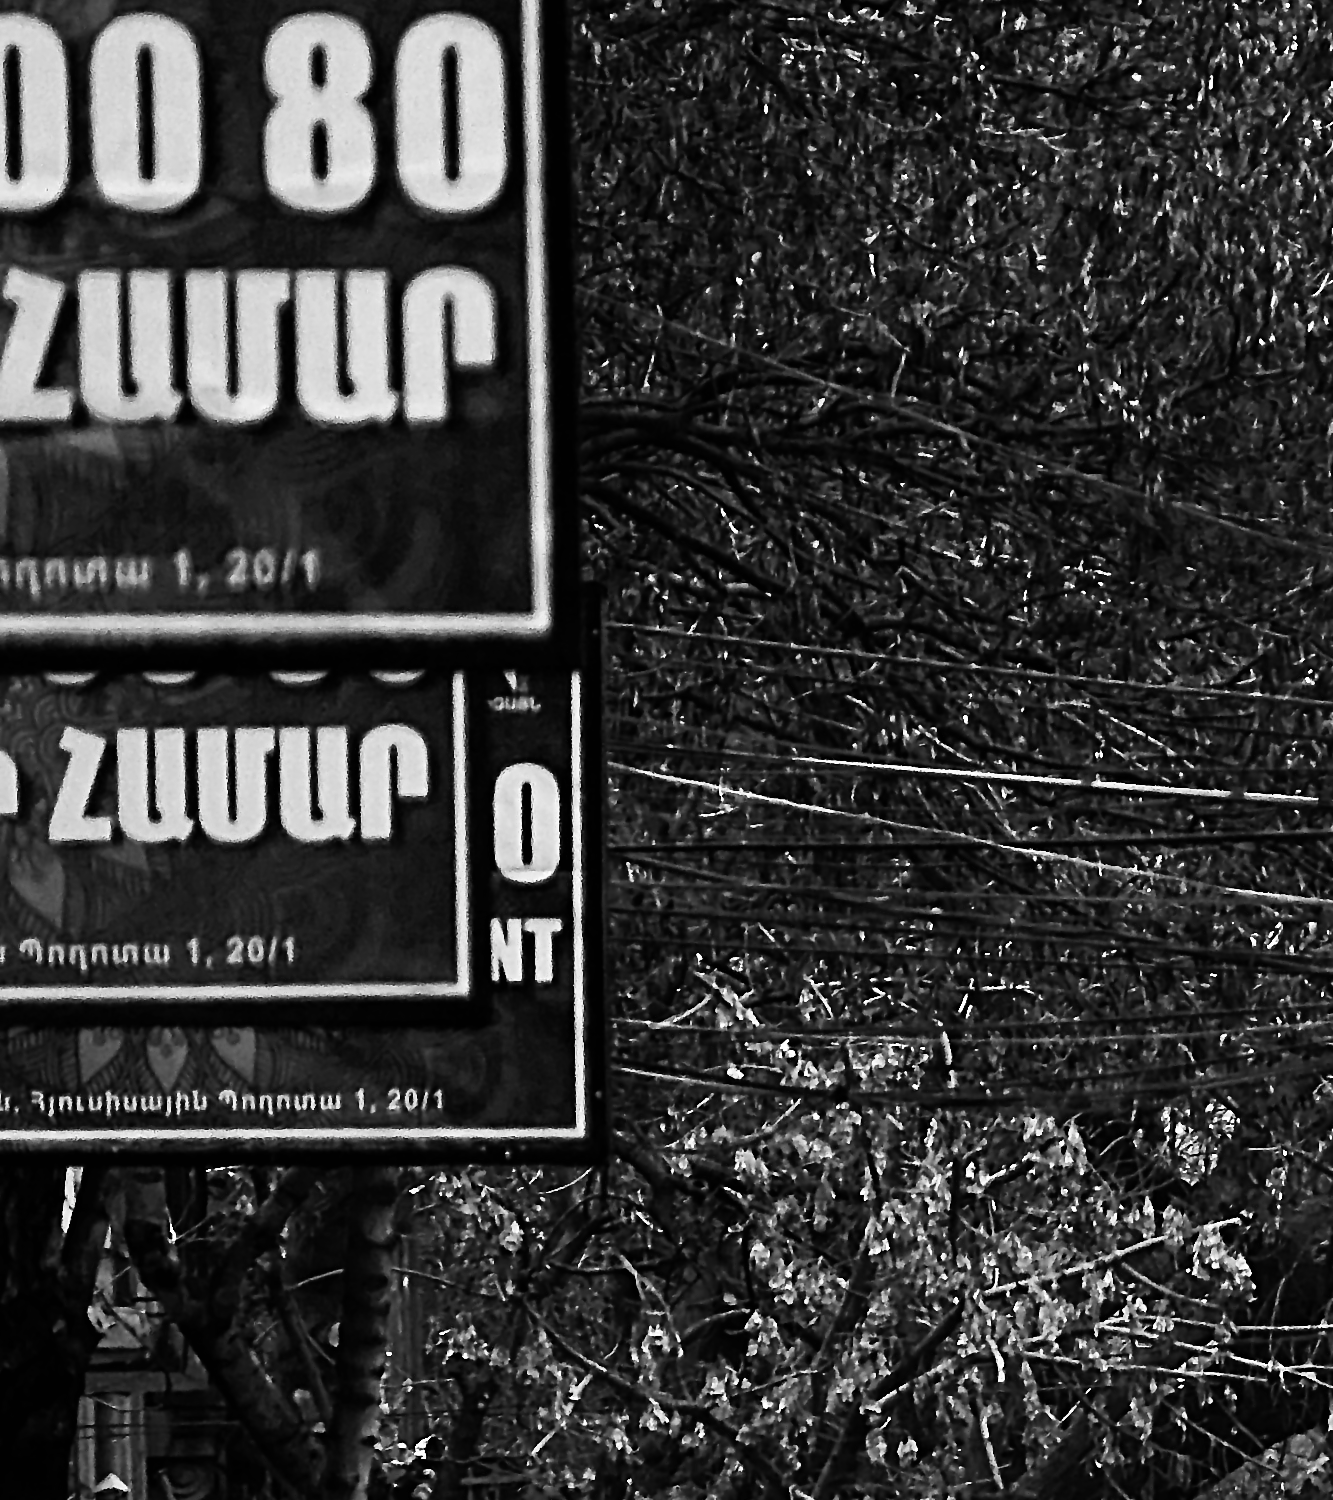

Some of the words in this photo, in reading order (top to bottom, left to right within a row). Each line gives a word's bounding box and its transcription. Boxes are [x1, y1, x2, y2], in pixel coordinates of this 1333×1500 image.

[263, 12, 507, 215] 80
[227, 548, 321, 590] 20/1
[48, 724, 429, 843] ՀԱՄԱՐ
[19, 938, 170, 972] Պողոտա
[226, 935, 296, 964] 20/1
[218, 1089, 342, 1116] Պողոտա
[386, 1088, 443, 1111] 20/1
